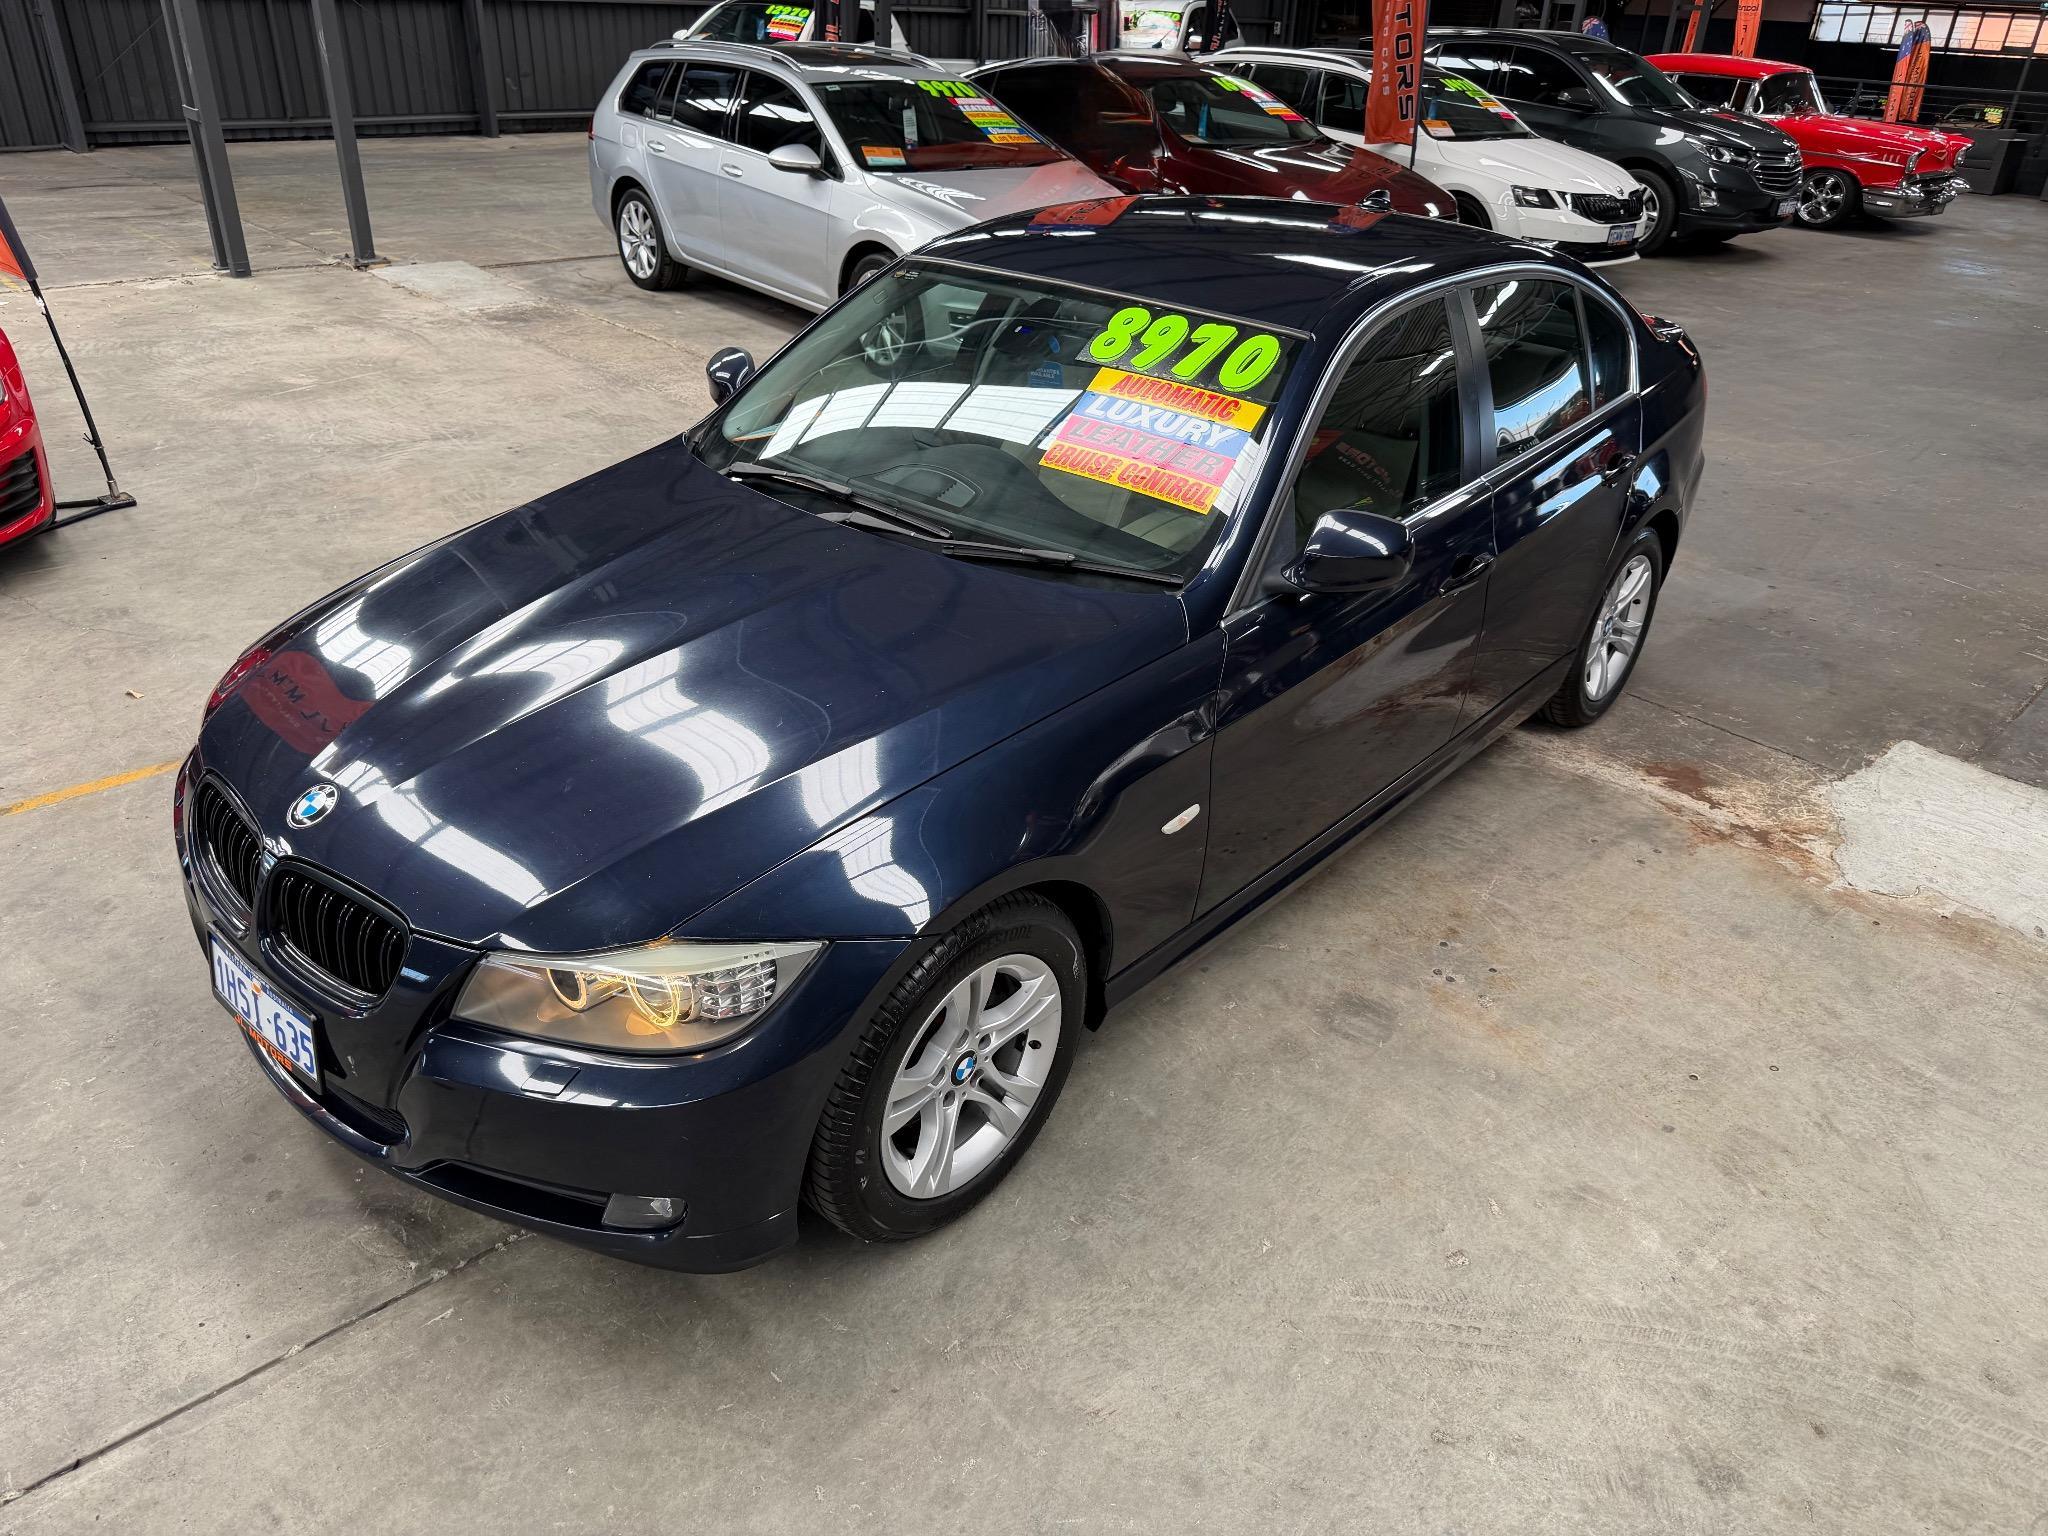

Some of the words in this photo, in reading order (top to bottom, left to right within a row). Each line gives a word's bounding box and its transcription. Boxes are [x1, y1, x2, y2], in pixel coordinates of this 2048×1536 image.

[765, 4, 810, 18] 12970
[1395, 2, 1414, 121] TORS
[917, 80, 977, 97] 9970
[1089, 307, 1280, 392] 8970
[1084, 395, 1240, 448] LUXURY
[1111, 374, 1242, 420] AUTOMATIC
[1067, 420, 1225, 477] LEATHER
[1044, 444, 1121, 482] CRUISE
[1116, 464, 1216, 511] CONTROL
[250, 1027, 293, 1072] MOTORS
